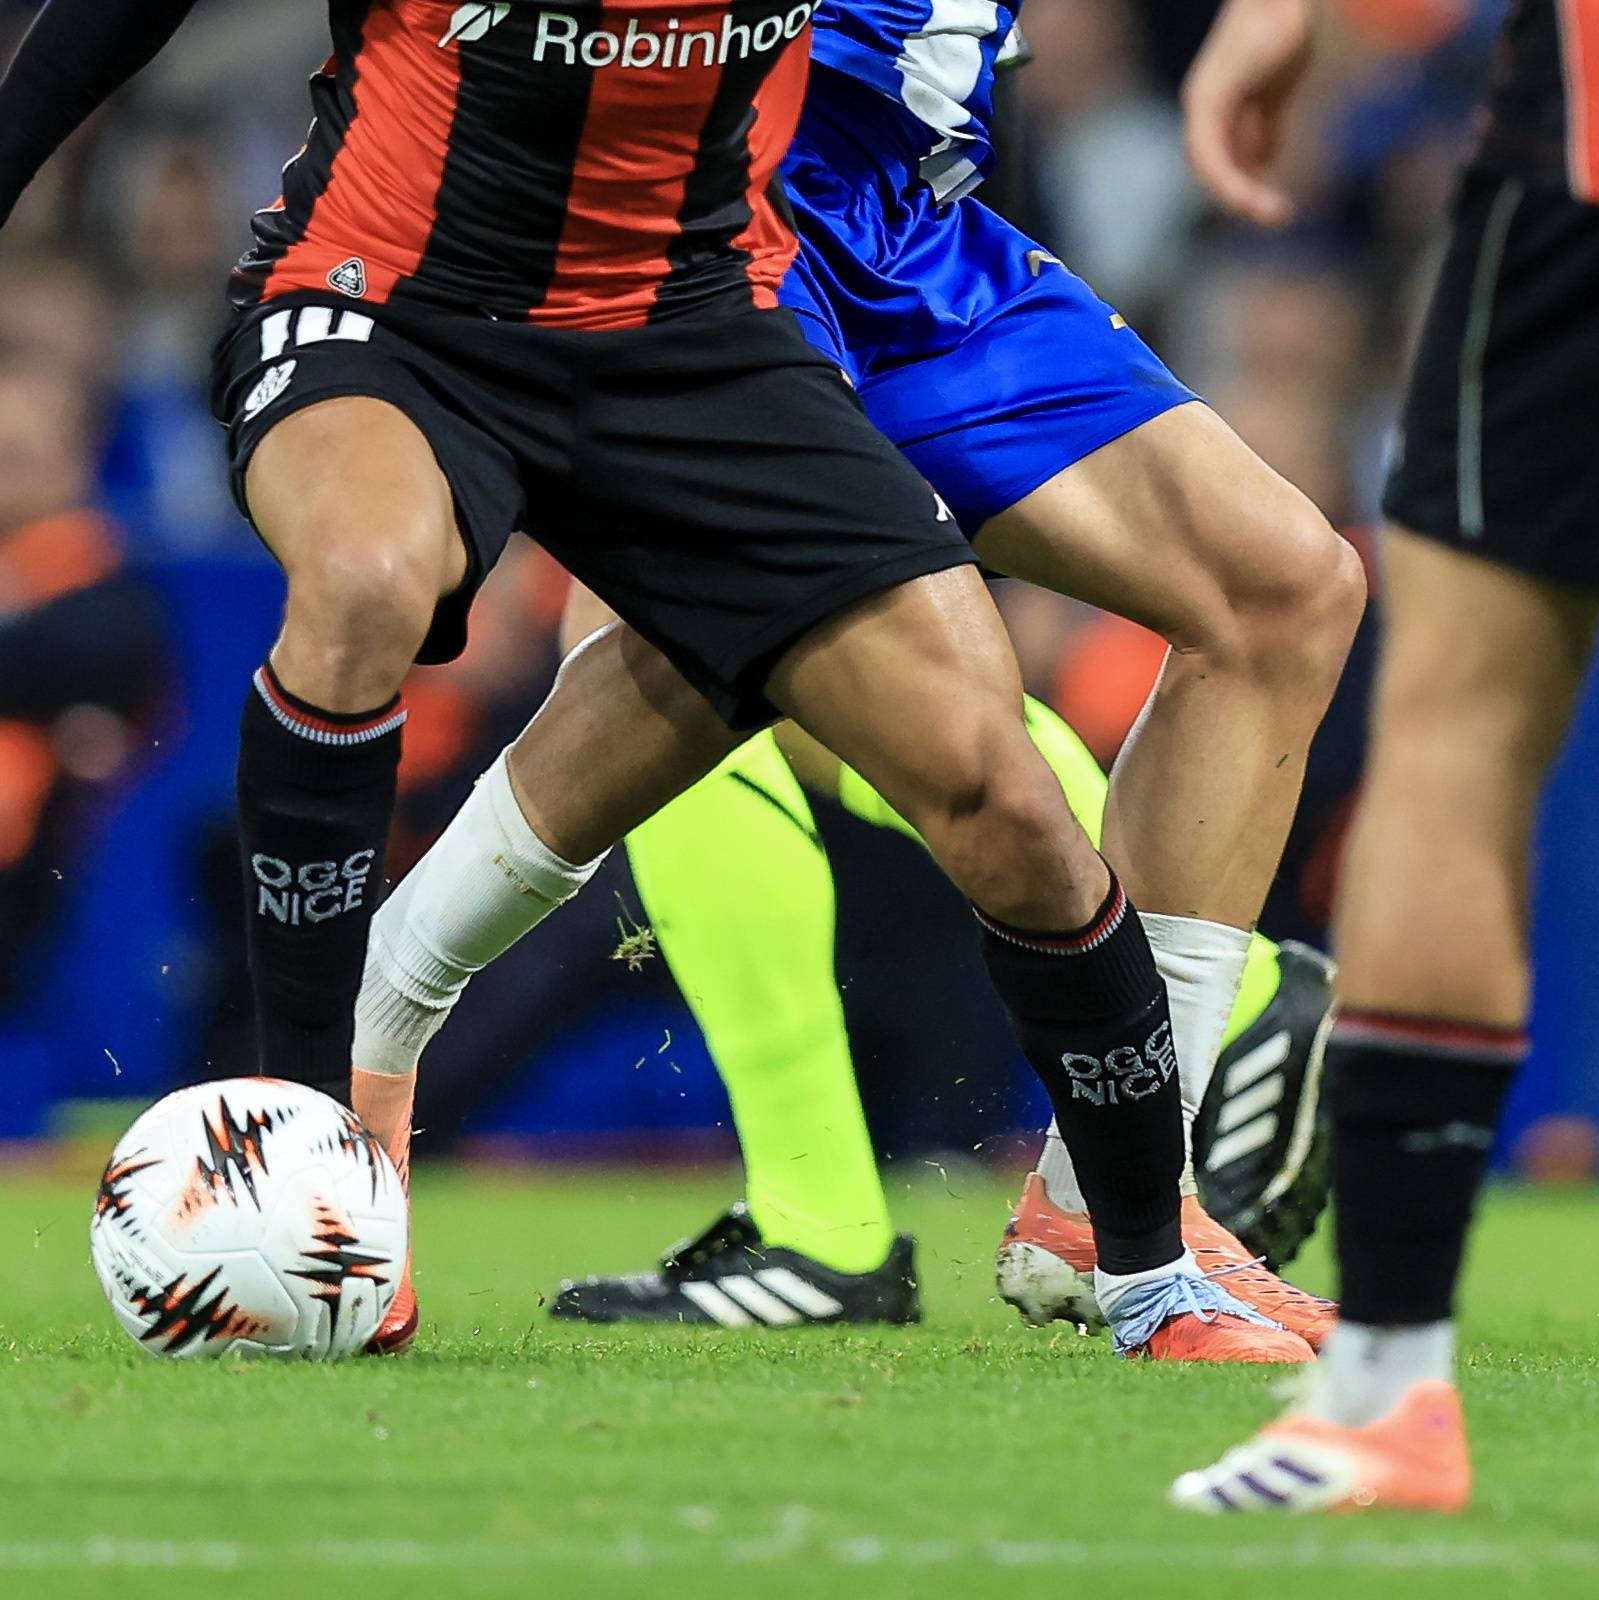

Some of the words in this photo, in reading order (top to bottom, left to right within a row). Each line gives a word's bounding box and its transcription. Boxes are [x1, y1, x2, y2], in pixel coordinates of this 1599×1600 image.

[252, 849, 375, 891] OGC
[258, 876, 367, 926] NICE
[1062, 1020, 1171, 1079] OGC
[1072, 1045, 1177, 1105] NICE
